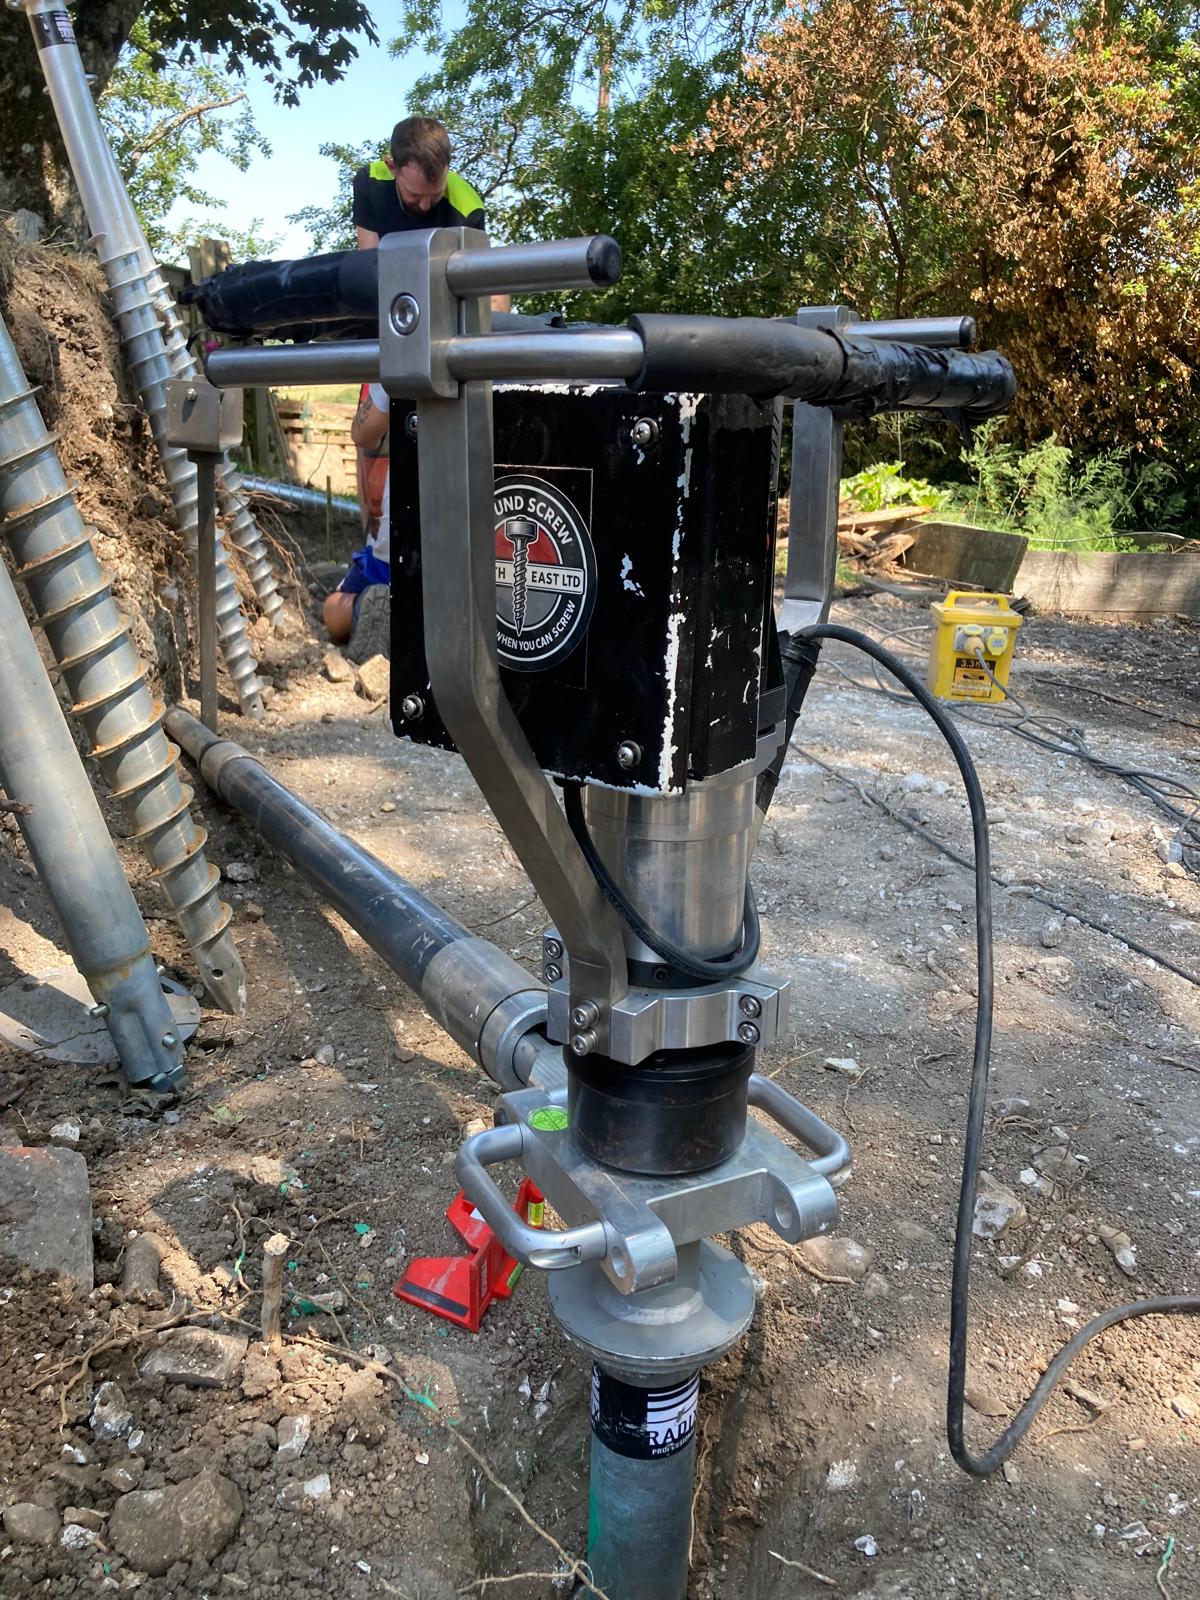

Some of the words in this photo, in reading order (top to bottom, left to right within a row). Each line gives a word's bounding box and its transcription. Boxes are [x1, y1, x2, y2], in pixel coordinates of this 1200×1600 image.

[527, 497, 573, 545] SCREW
[531, 571, 559, 586] EAST
[562, 574, 580, 588] LTD
[518, 641, 535, 651] YOU
[535, 632, 553, 649] CAN
[552, 599, 576, 637] SCREW
[960, 659, 975, 668] 3.3
